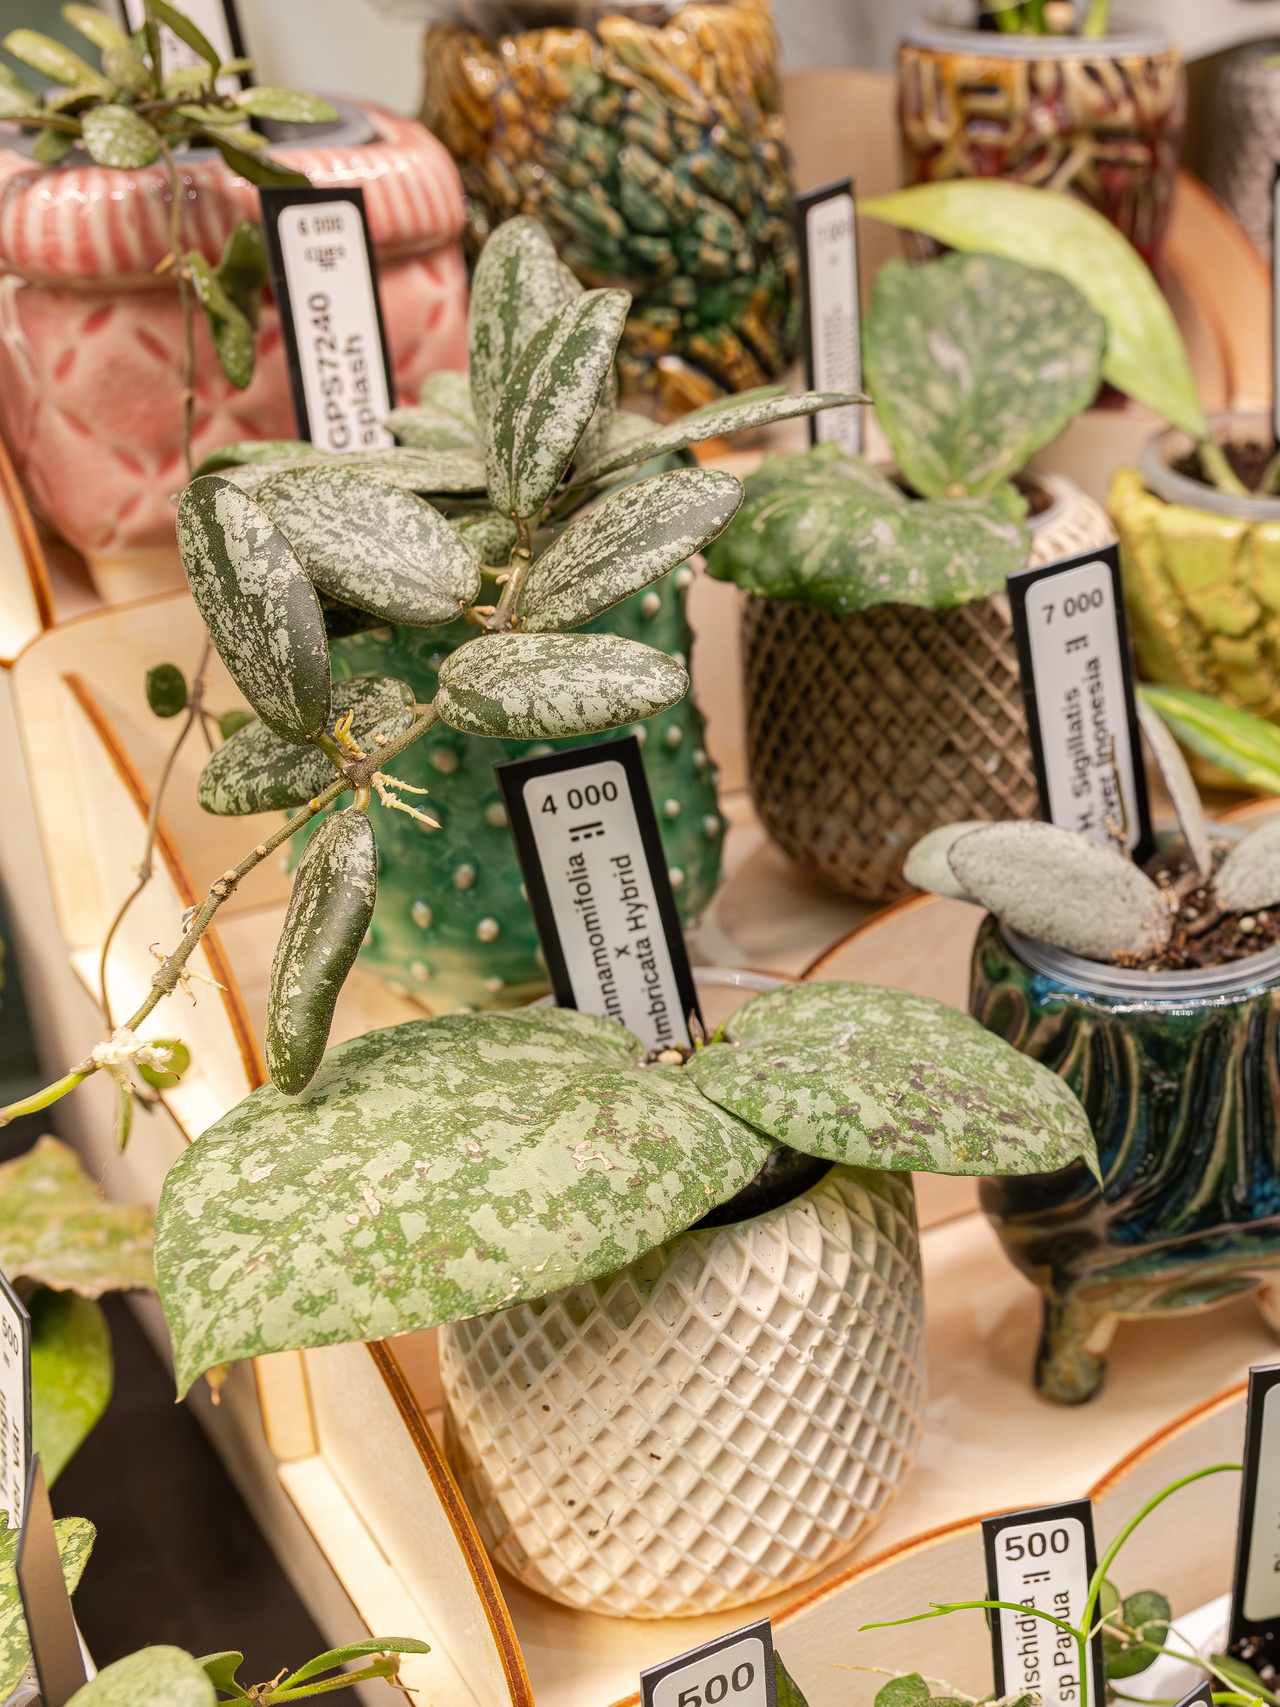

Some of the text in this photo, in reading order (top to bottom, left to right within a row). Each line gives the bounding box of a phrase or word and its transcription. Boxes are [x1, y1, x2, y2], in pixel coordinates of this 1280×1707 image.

[308, 294, 351, 449] GPS7240
[343, 333, 377, 446] splash
[1042, 588, 1104, 625] 7 000
[541, 780, 619, 816] 4 000
[567, 852, 626, 1027] innamomifolia
[610, 854, 673, 1044] Imbricata Hybrid
[1005, 1528, 1070, 1561] 500
[678, 1662, 755, 1707] 500
[1014, 1595, 1043, 1702] ischidia
[1053, 1590, 1080, 1701] sp Papua
